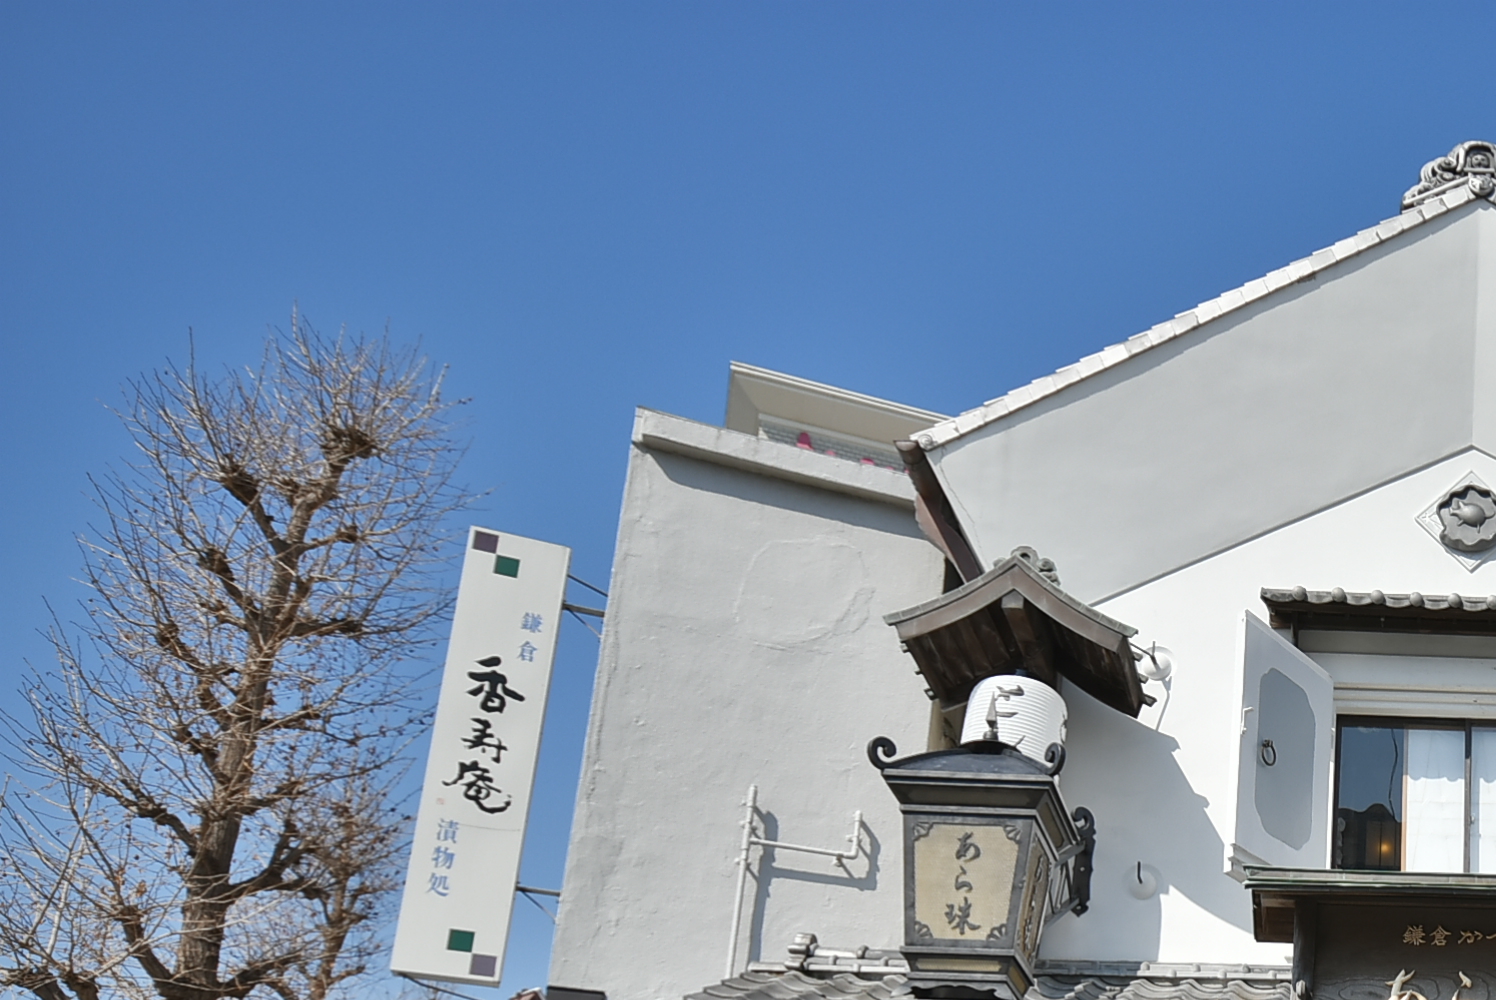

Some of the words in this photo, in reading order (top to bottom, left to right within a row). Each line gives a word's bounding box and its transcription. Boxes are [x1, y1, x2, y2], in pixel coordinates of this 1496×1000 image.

[518, 611, 543, 664] 鎌倉
[427, 817, 460, 897] 漬物処
